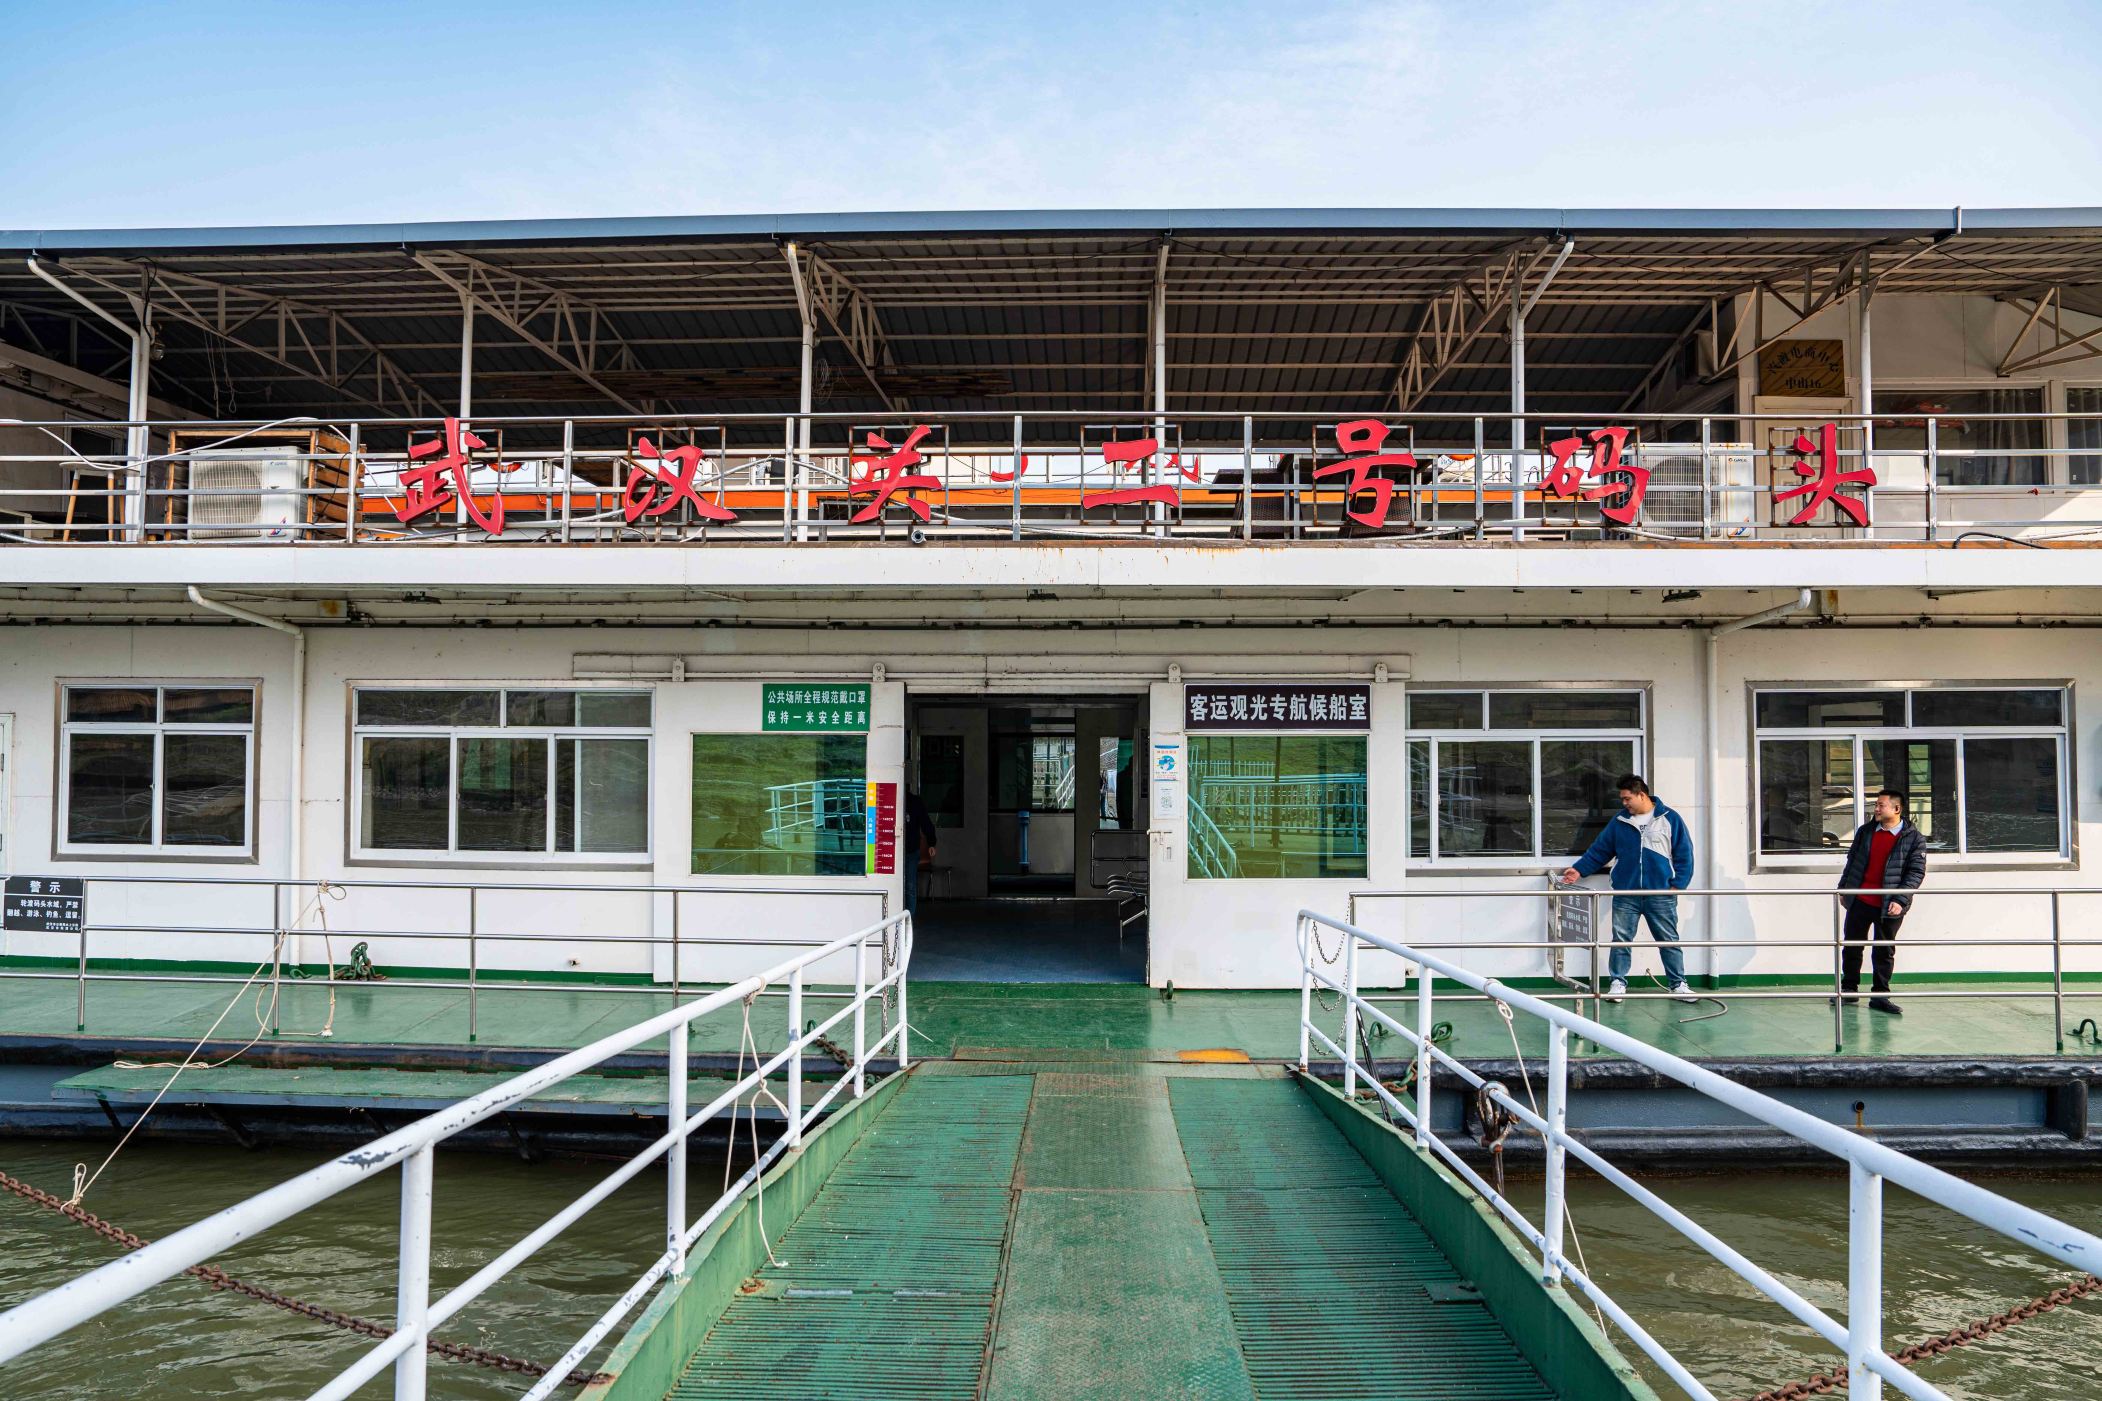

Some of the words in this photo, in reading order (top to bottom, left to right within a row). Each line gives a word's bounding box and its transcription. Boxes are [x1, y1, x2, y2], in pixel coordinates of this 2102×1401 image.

[393, 416, 1877, 537] 武汉关二号码头
[767, 690, 866, 704] 公共场所全程规范戴口罩
[1190, 693, 1367, 721] 客运观光专航候船室
[767, 710, 866, 725] 保持一米安全距离
[29, 880, 61, 894] 警示
